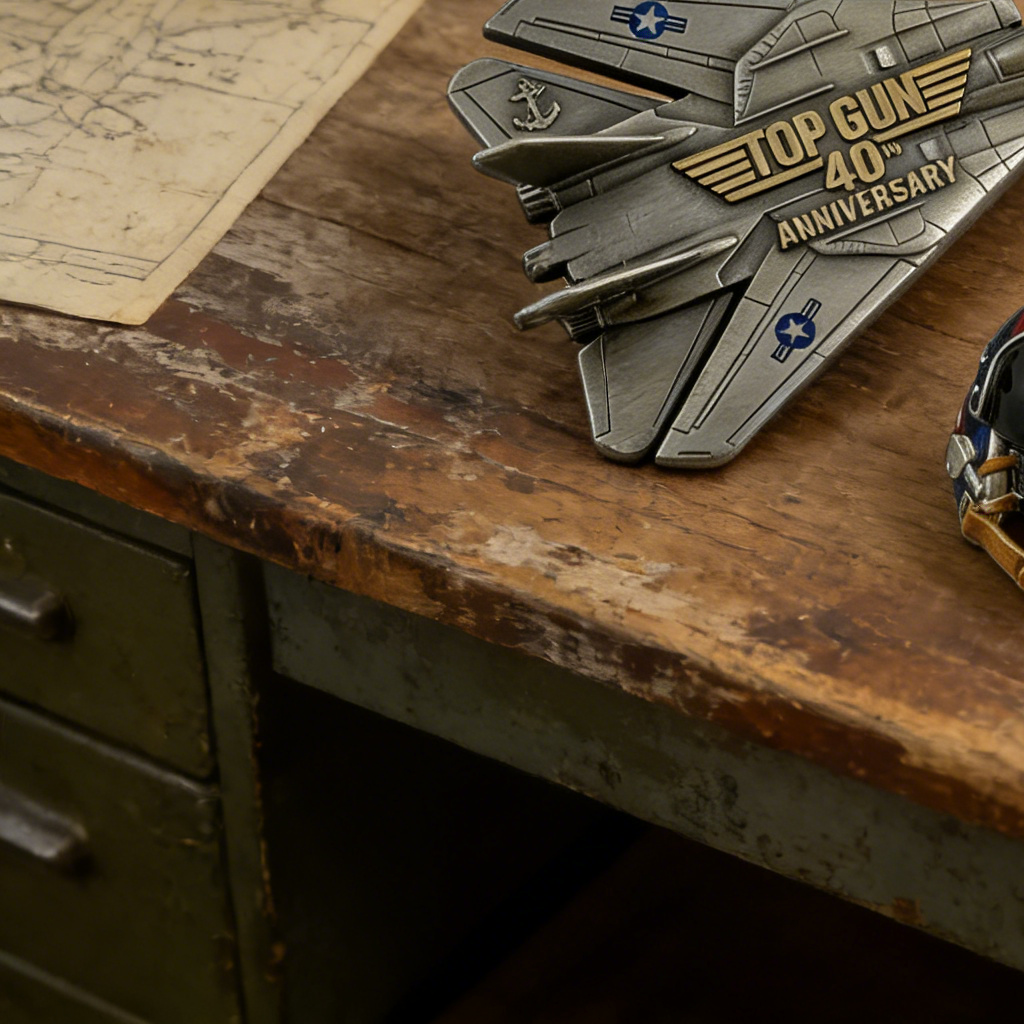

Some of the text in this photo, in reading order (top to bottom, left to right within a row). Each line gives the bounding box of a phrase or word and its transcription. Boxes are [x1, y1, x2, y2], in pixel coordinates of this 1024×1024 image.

[743, 77, 927, 177] TOP GUN
[776, 155, 956, 250] ANNIVERSARY
